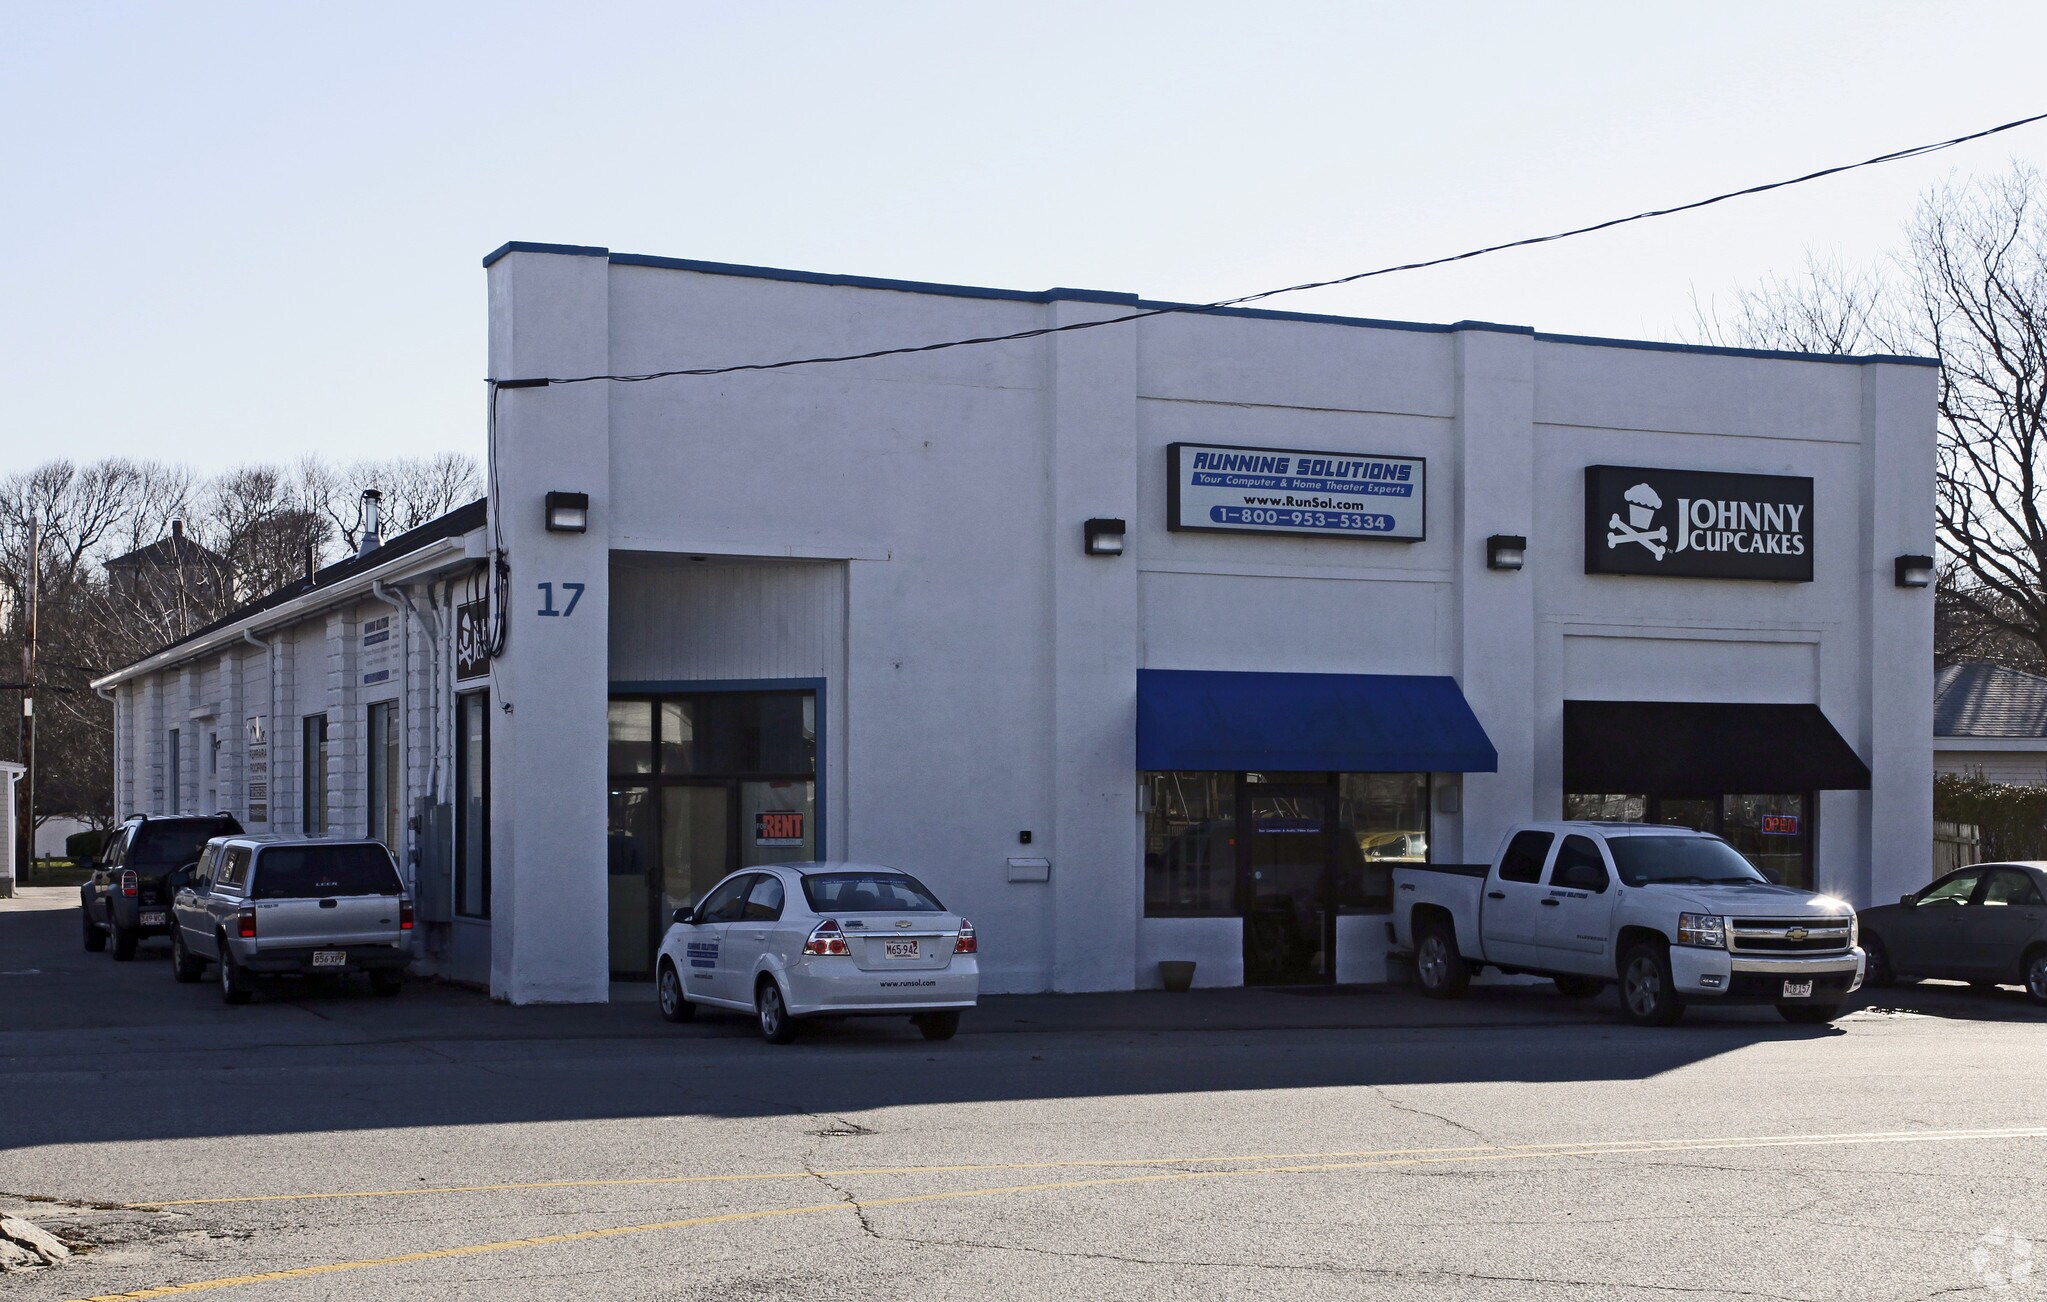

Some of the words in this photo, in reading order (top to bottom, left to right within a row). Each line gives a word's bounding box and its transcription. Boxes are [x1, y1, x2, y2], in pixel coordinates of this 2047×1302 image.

[1193, 452, 1290, 474] RUNNING
[1296, 458, 1412, 482] SOLUTIONS
[1199, 473, 1222, 484] Your
[1226, 475, 1276, 488] Computer
[1279, 477, 1288, 487] &
[1292, 479, 1322, 489] Home
[1326, 481, 1364, 493] Theater
[1367, 483, 1405, 495] Experts
[1243, 496, 1364, 511] www.RunSol.com
[1220, 508, 1386, 530] 1-800-953-5334
[1674, 498, 1805, 553] JOHNNY
[1689, 529, 1805, 556] CUPCAKES
[537, 582, 586, 617] 17
[763, 815, 803, 838] RENT
[1764, 817, 1795, 833] OPEN
[879, 978, 936, 988] www.runsol.com
